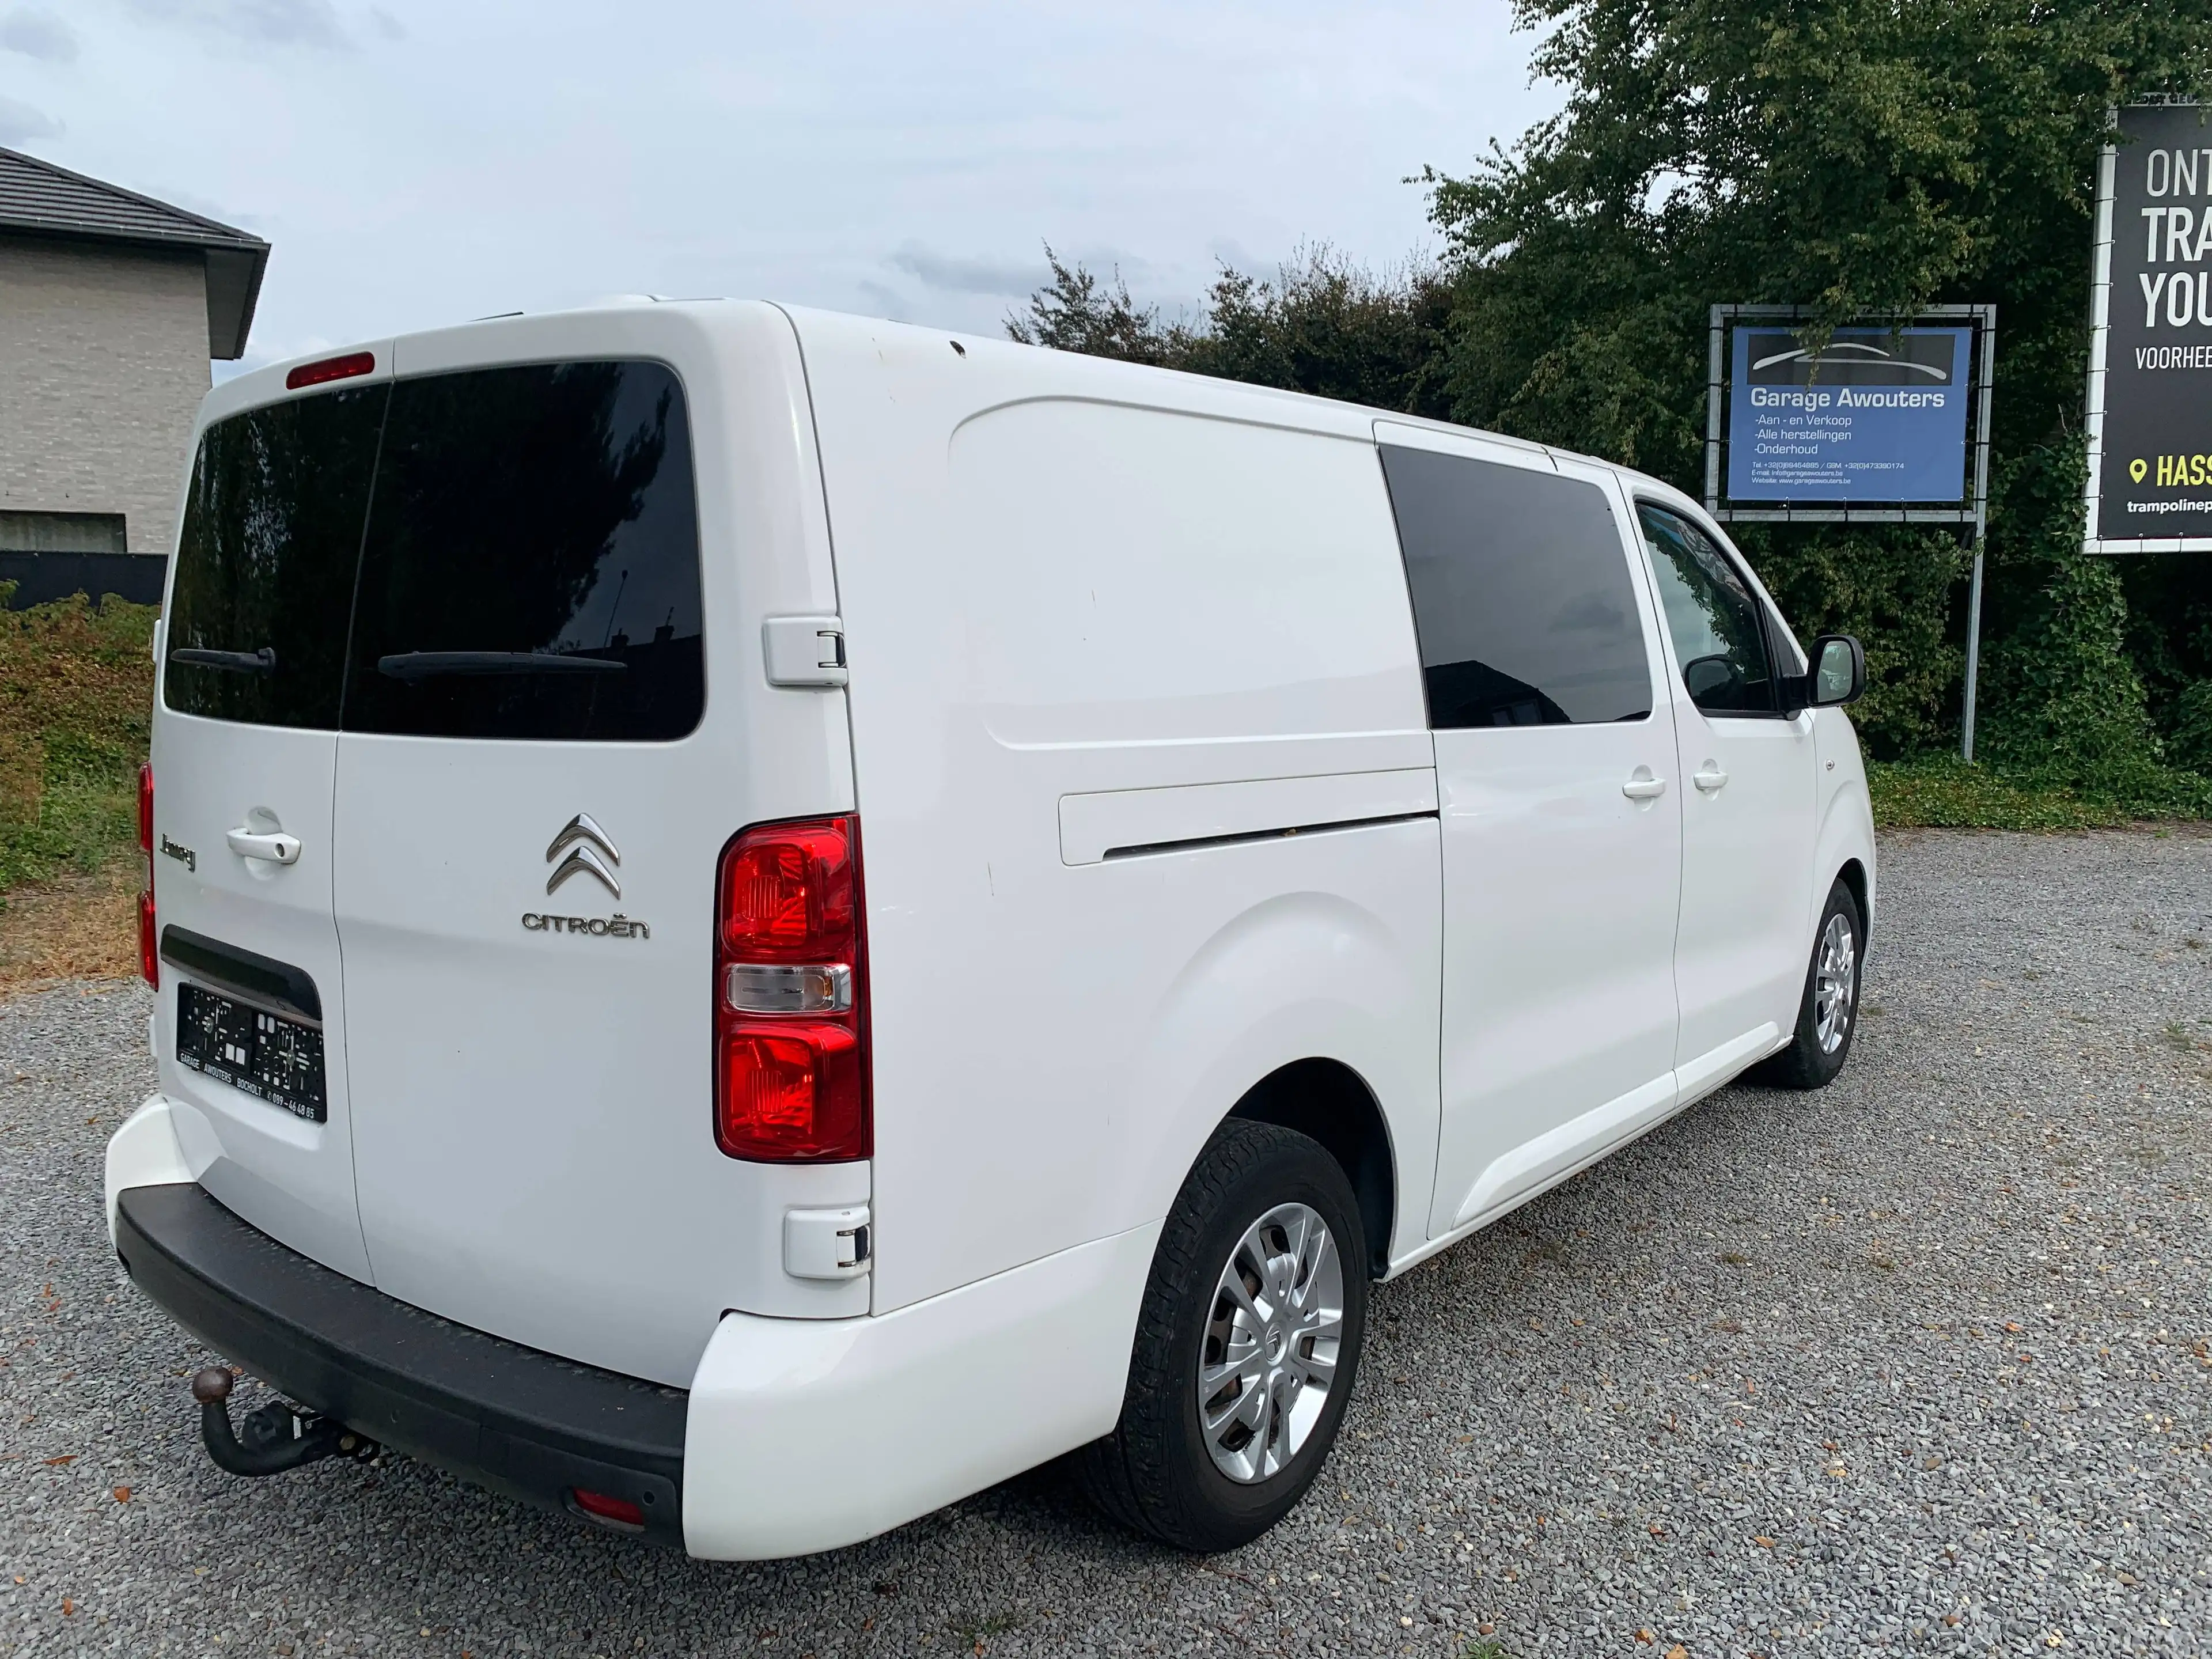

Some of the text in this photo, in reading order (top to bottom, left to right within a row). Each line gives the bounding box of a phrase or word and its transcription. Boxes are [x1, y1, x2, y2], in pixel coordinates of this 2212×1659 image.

[2147, 149, 2212, 196] ONT
[2141, 206, 2212, 262] TRA
[2135, 346, 2212, 369] VOORHEE
[1751, 387, 1945, 412] Garage Awouters
[1789, 417, 1803, 425] en
[1806, 415, 1852, 427] Verkoop
[1781, 429, 1851, 442] herstellingen
[1754, 443, 1818, 454] -Onderhoud
[180, 1052, 200, 1069] GARAGE
[204, 1062, 232, 1083] AWOUTERS
[237, 1077, 262, 1097] BOCHOLT
